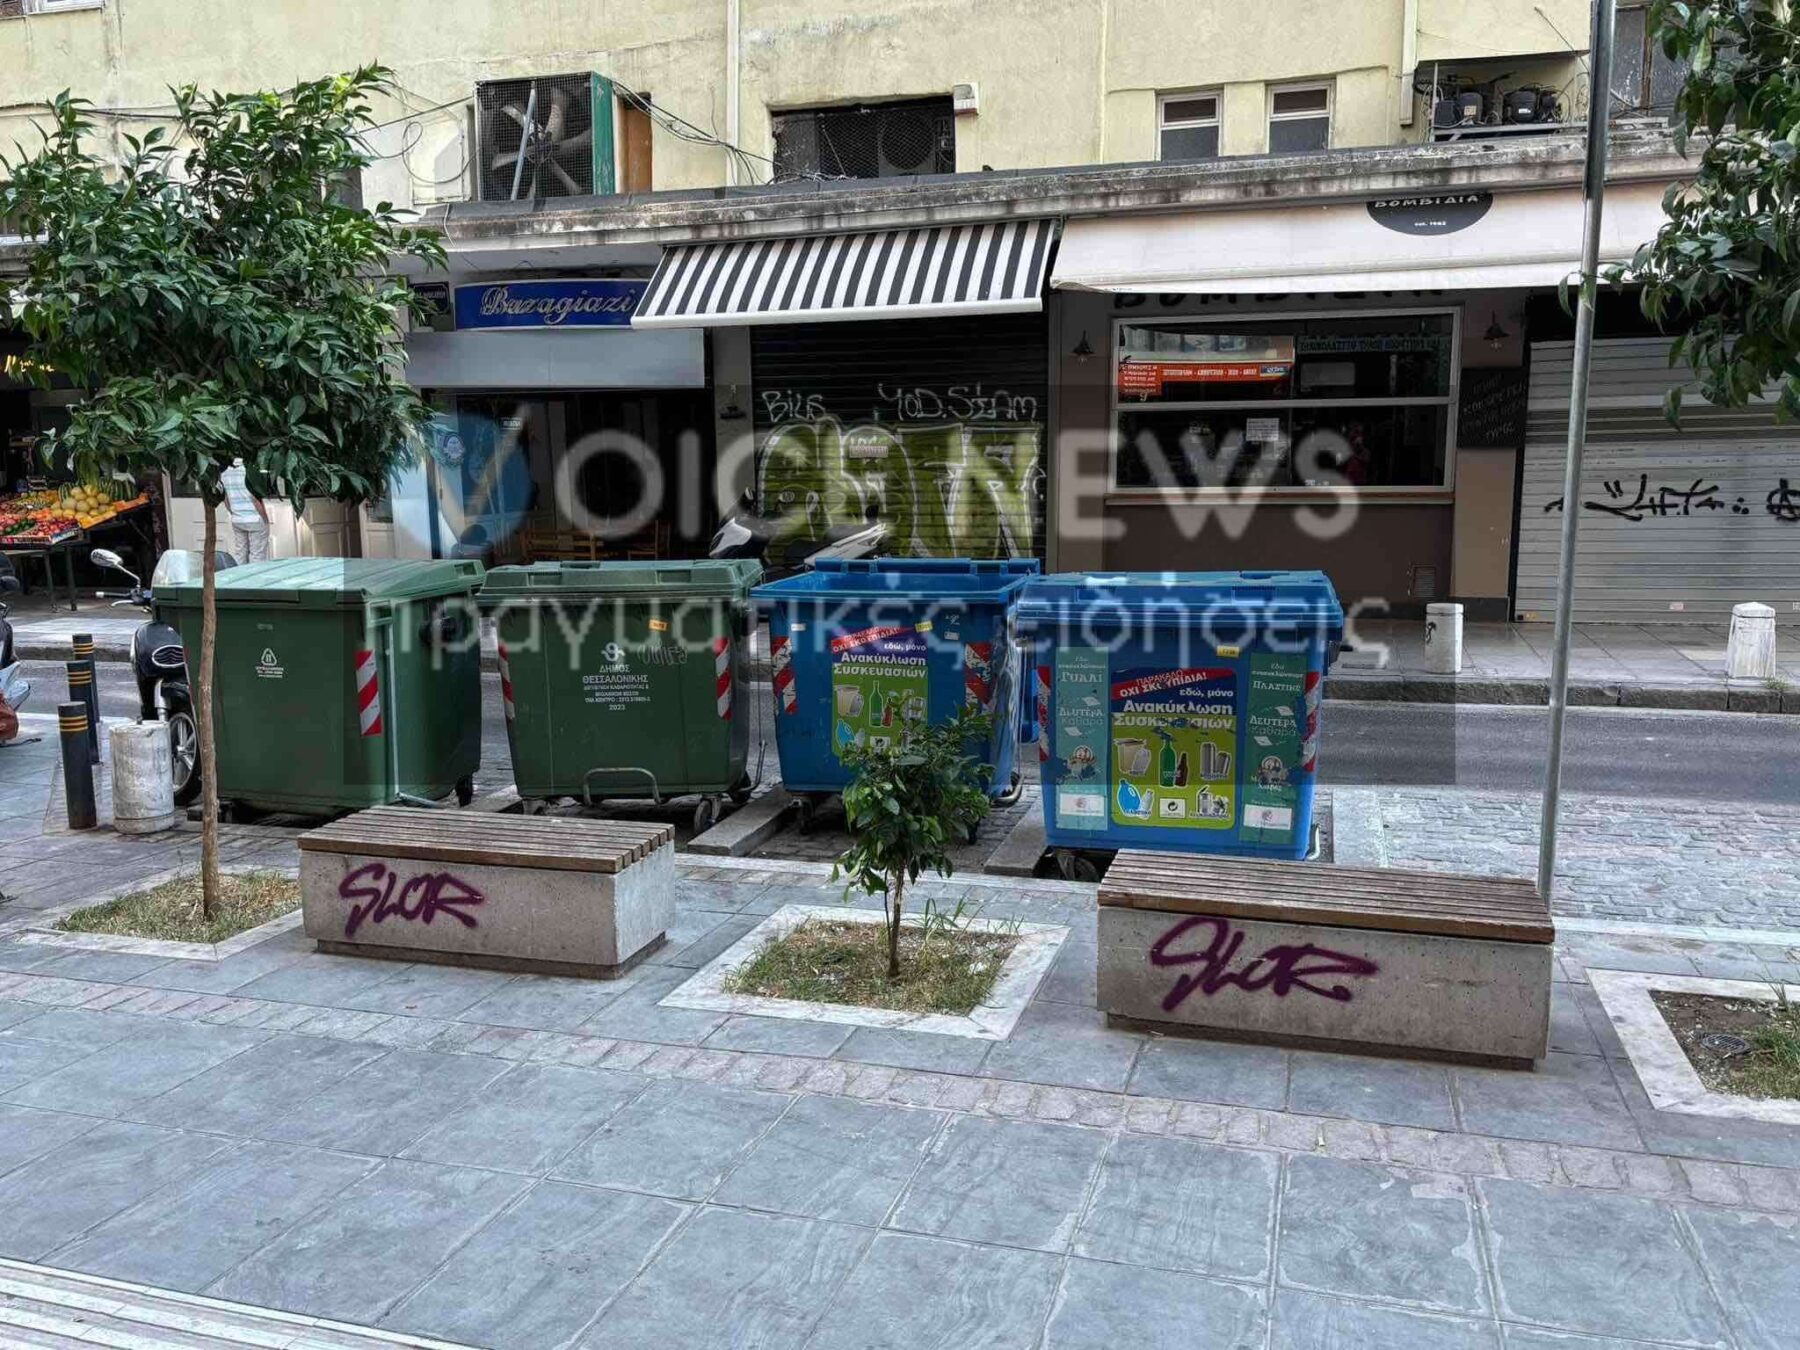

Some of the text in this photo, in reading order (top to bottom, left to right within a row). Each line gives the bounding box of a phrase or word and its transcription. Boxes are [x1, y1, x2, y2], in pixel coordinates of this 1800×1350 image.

[841, 652, 926, 666] Ανακύκλωση
[599, 664, 631, 674] ΔΗΜΟΣ
[833, 662, 927, 678] Συσκευασιών
[582, 674, 649, 684] ΘΕΣΣΑΛΟΝΙΚΗΣ
[1120, 686, 1139, 698] ΟΧΙ
[1180, 687, 1234, 698] εδώ, μόνο
[1123, 700, 1233, 715] Ανακύκλωση
